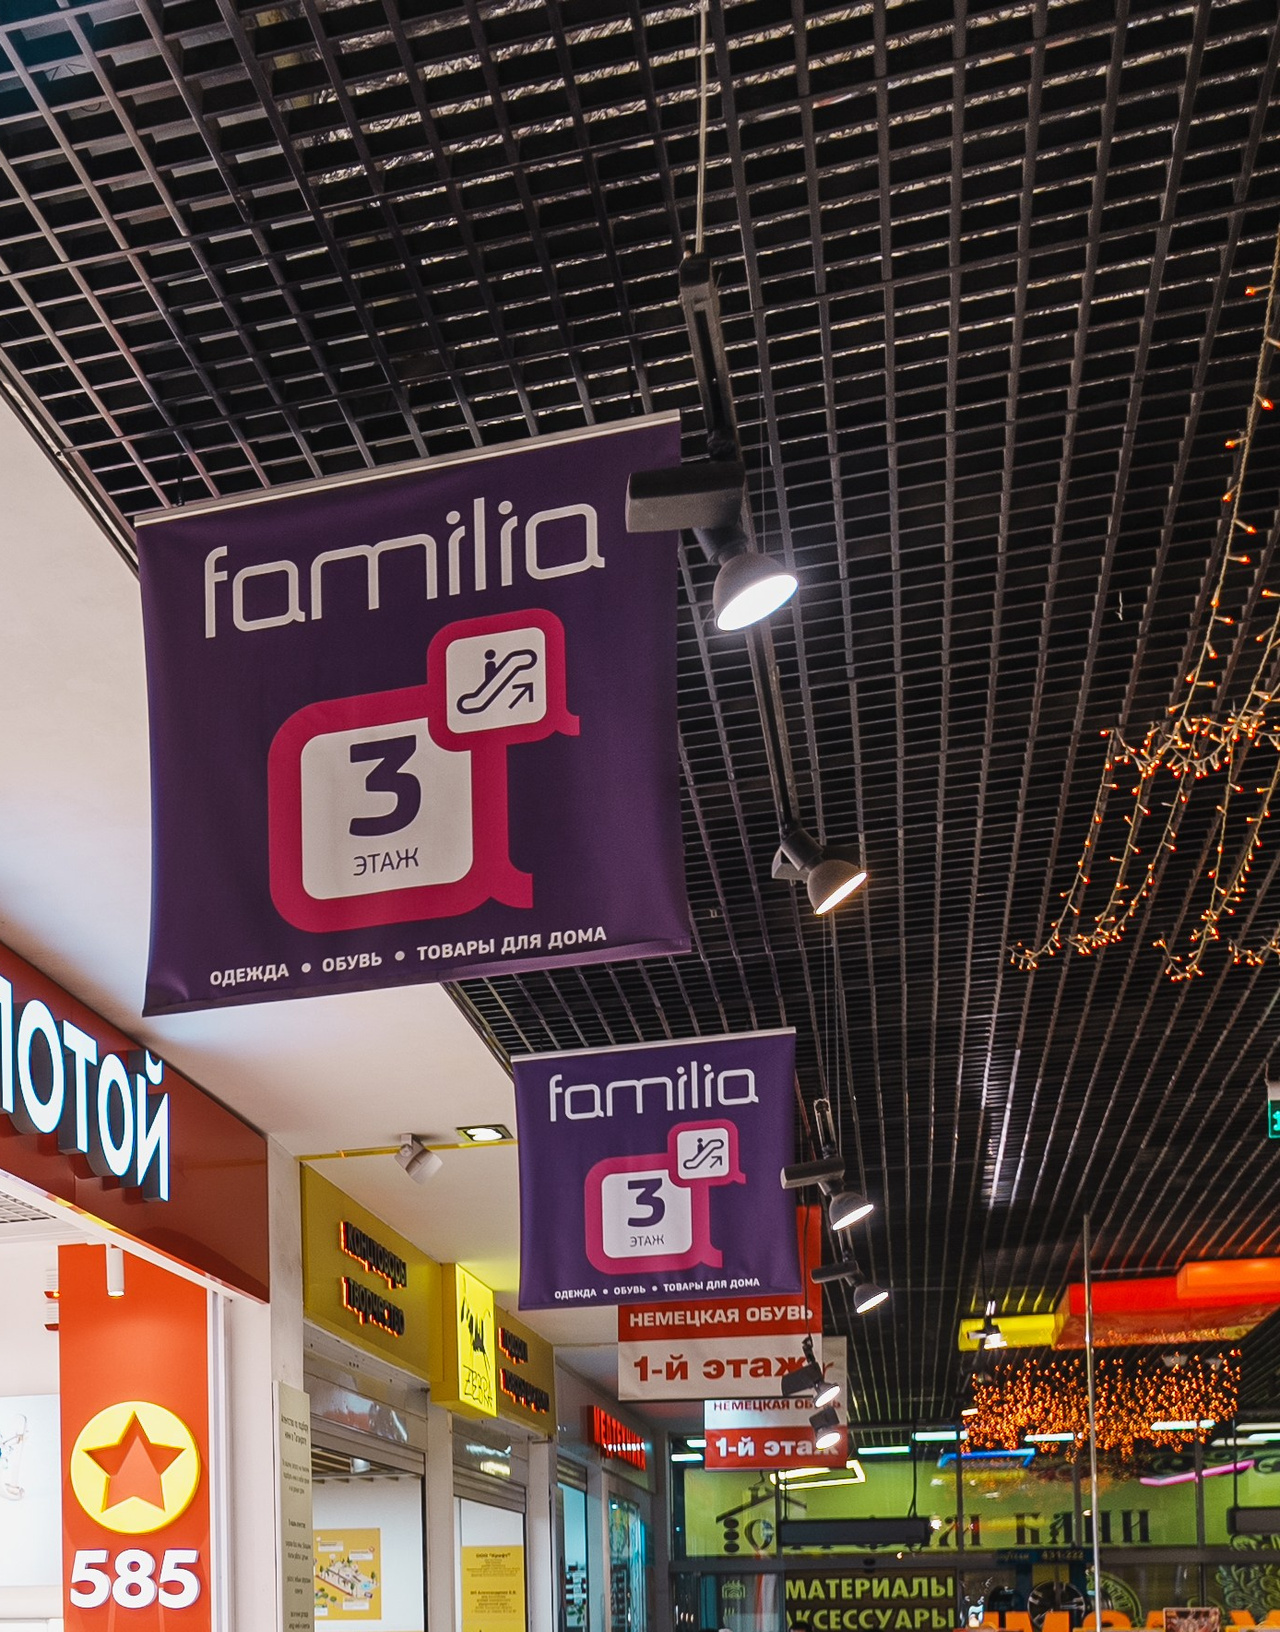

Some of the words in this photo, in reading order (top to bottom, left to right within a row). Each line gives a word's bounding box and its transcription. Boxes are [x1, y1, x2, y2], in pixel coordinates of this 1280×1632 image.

[205, 497, 605, 638] familia
[349, 734, 422, 838] 3
[353, 847, 419, 876] ЭТАЖ
[209, 963, 289, 987] ОДЕЖДА
[322, 952, 382, 974] ОБУВЬ
[416, 938, 496, 962] ТОВАРЫ
[501, 931, 542, 953] ДЛЯ
[547, 926, 607, 949] ДОМА
[549, 1060, 759, 1122] familia
[627, 1177, 666, 1228] 3
[629, 1233, 665, 1248] ЭТАЖ
[554, 1287, 597, 1300] ОДЕЖДА
[613, 1284, 646, 1296] ОБУВЬ
[663, 1281, 704, 1292] ТОВАРЫ
[706, 1279, 728, 1291] ДЛЯ
[729, 1277, 760, 1289] ДОМА
[629, 1306, 739, 1327] НЕМЕЦКАЯ
[746, 1304, 813, 1324] ОБУВЬ
[633, 1352, 689, 1382] 1-й
[714, 1399, 790, 1412] НЕМЕЦКАЯ
[715, 1436, 755, 1457] 1-й
[70, 1549, 201, 1609] 585
[786, 1576, 954, 1600] МАТЕРИАЛЫ
